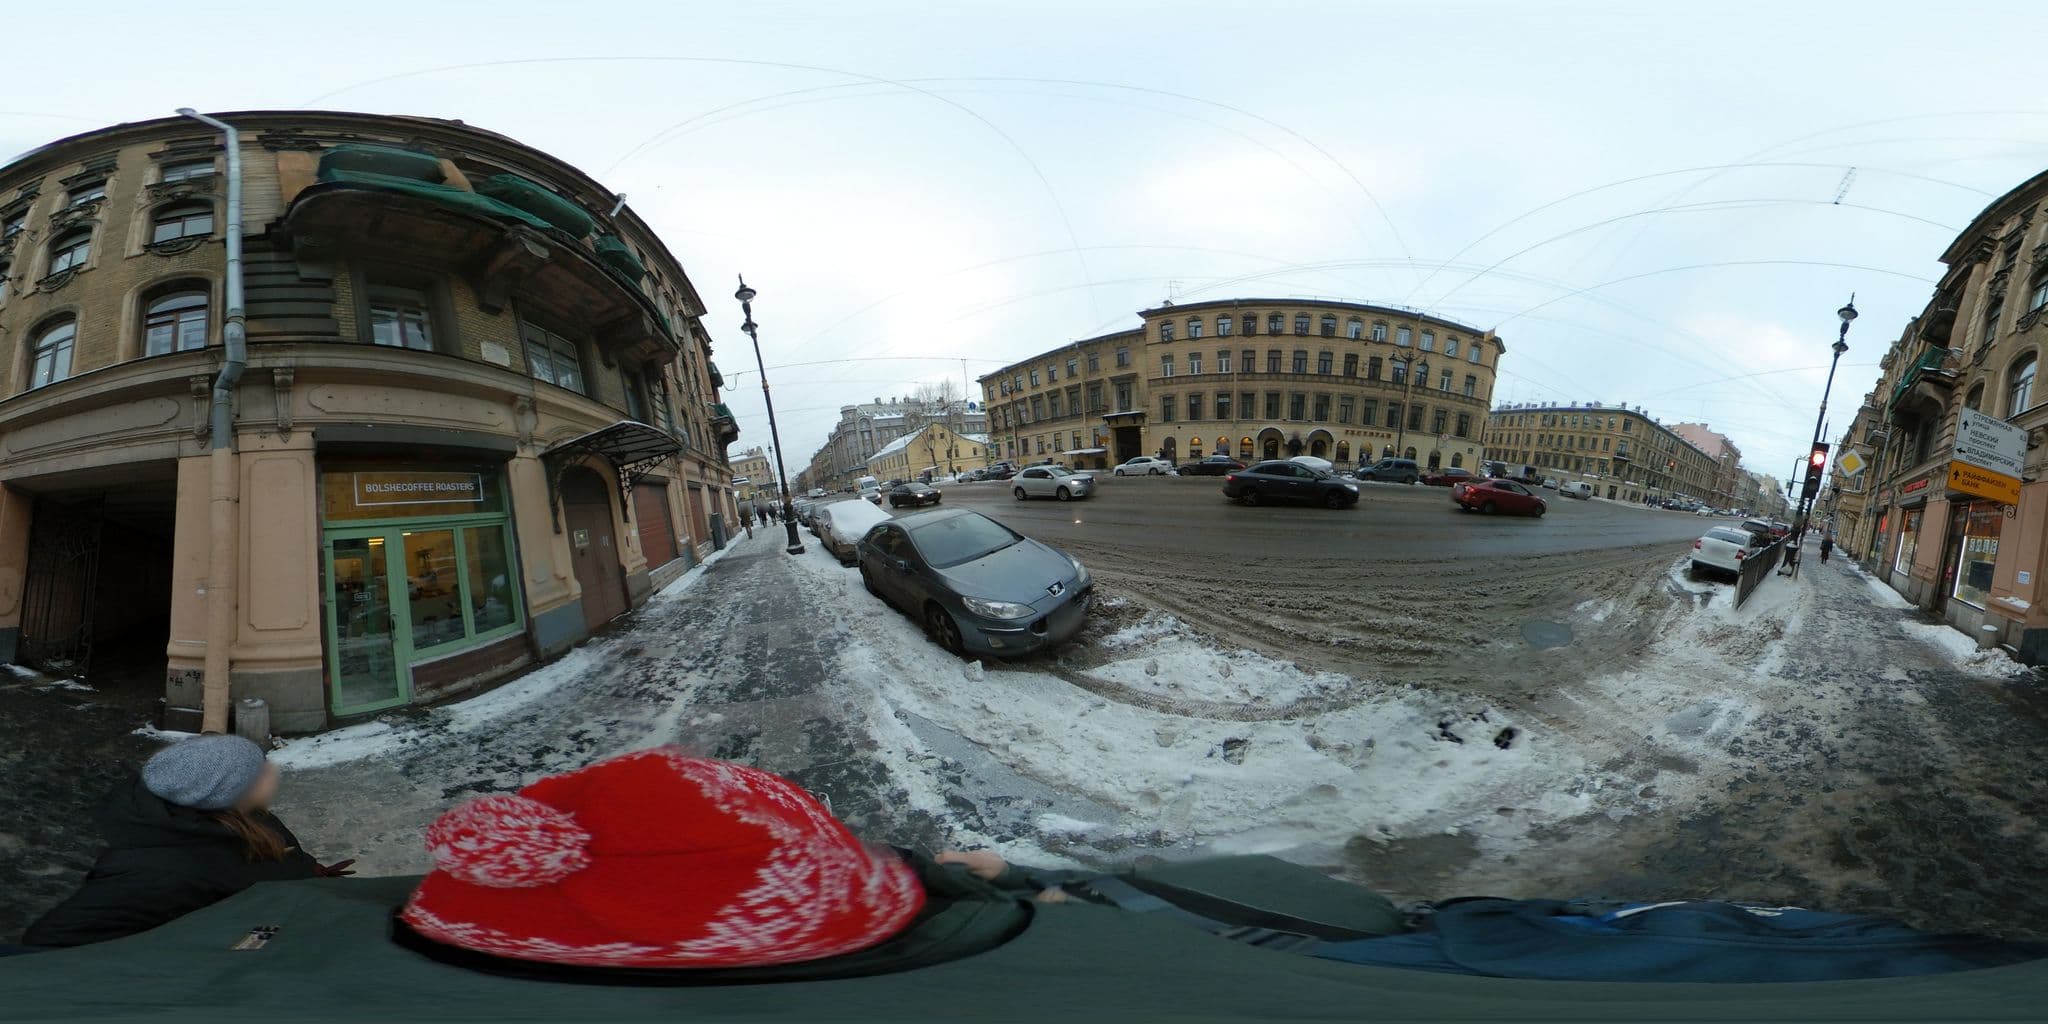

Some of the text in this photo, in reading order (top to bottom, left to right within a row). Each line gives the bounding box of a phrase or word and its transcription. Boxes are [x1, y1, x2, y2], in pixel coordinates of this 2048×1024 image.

[1970, 429, 2000, 444] НЕВСКИЙ
[1967, 446, 2015, 468] ВЛАДИМИРСКИЙ
[365, 482, 475, 493] BOLSHECOFFEE ROASTERS
